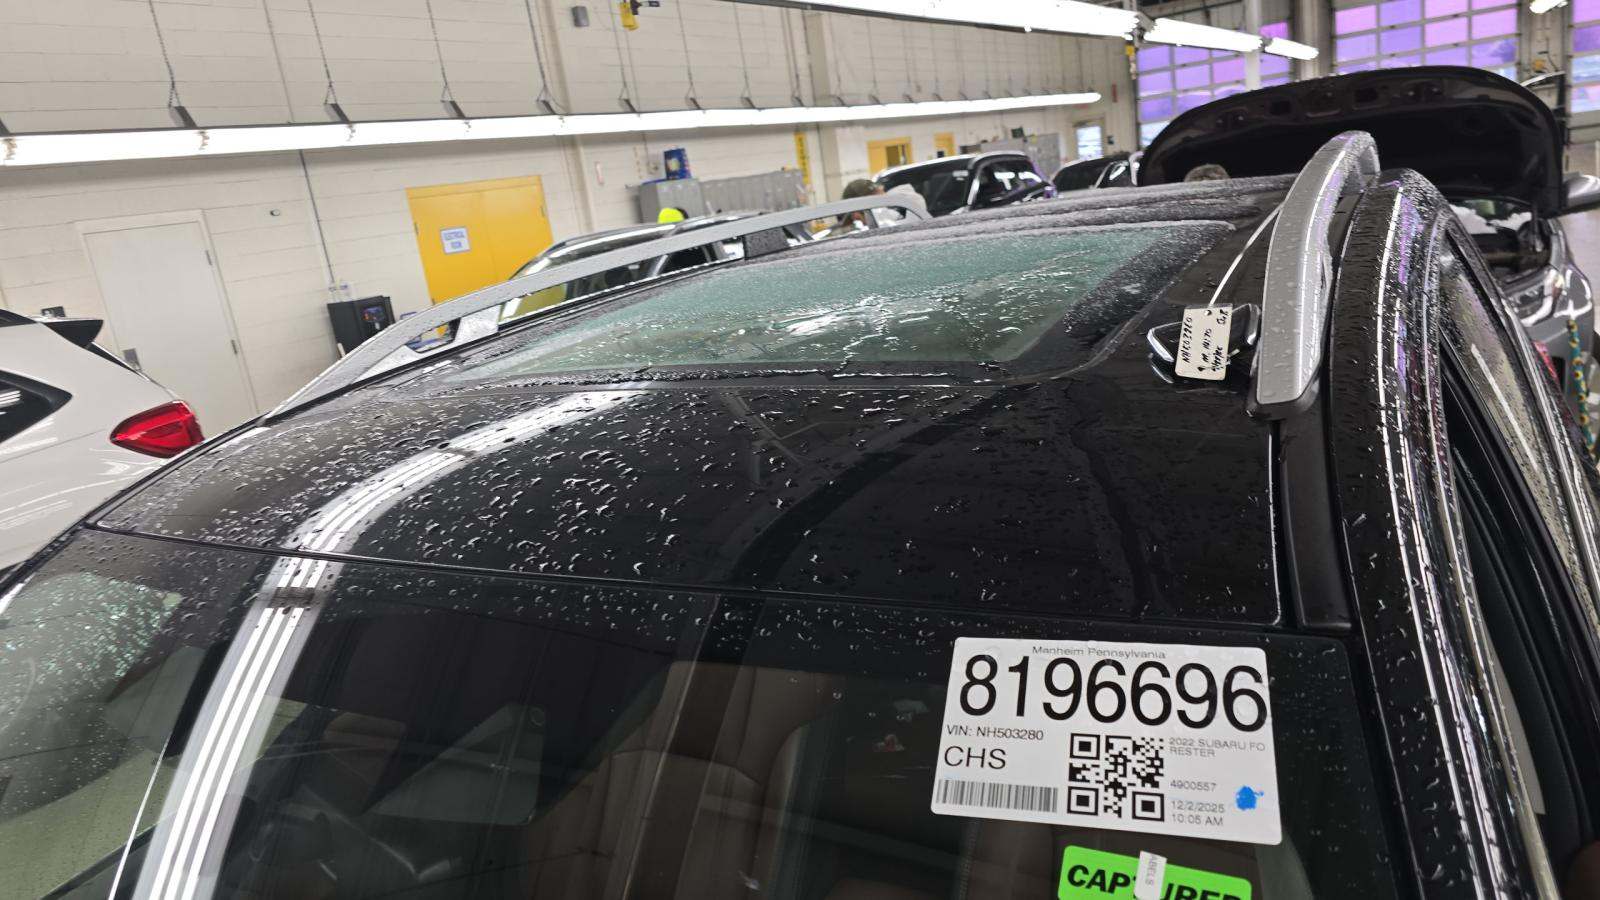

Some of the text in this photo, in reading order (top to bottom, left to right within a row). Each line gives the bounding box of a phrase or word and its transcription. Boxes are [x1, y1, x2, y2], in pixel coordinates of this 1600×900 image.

[1032, 646, 1167, 660] Manheim Pennsylvania
[959, 654, 1268, 732] 8196696
[946, 724, 1044, 741] VIN: NH503280
[1169, 737, 1266, 752] 2022 SUBARU FO
[1169, 746, 1216, 757] RESTER
[944, 745, 1007, 770] CHS
[1170, 780, 1217, 792] 4900557
[1172, 800, 1226, 814] 12/2/2025
[1172, 813, 1224, 827] 10:05 AM
